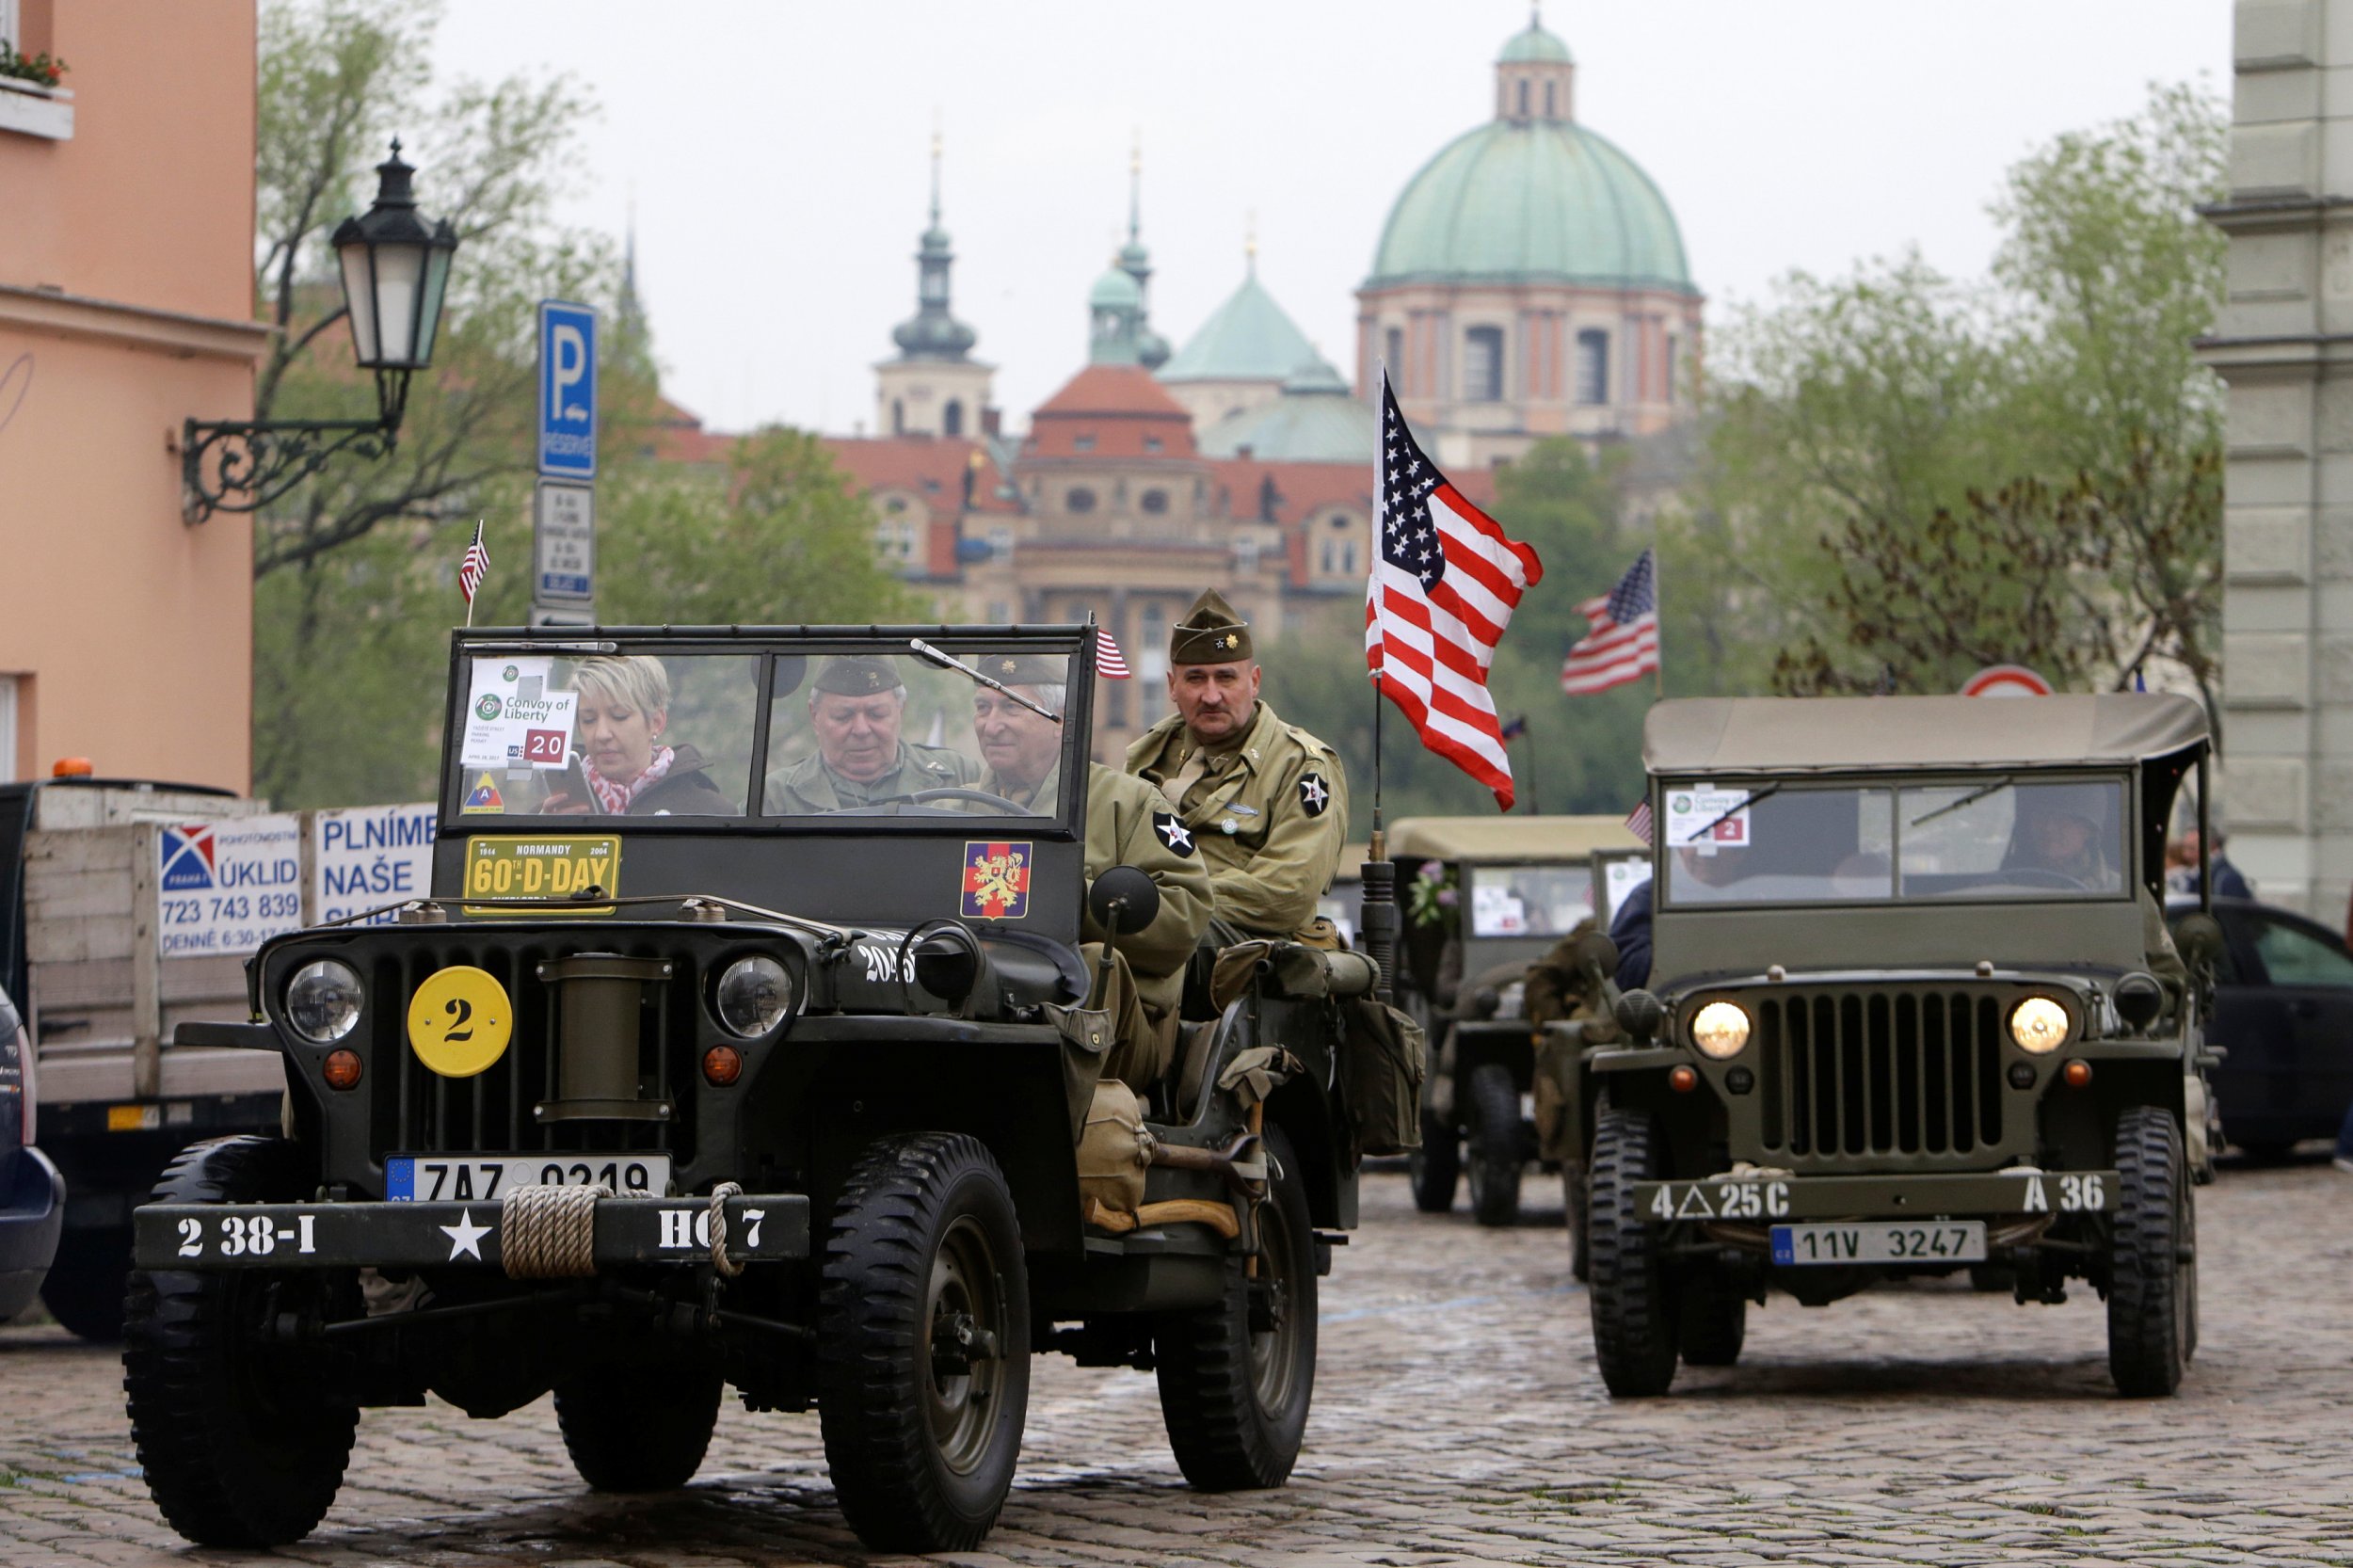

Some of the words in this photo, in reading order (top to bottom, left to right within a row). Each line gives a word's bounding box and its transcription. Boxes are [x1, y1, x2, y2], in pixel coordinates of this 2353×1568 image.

[552, 324, 586, 421] P
[504, 708, 549, 724] Liberty
[506, 696, 553, 712] Convoy
[555, 699, 570, 711] of
[531, 735, 561, 755] 20
[480, 789, 489, 799] A
[516, 845, 571, 856] NORMANDY
[220, 856, 297, 888] ÚKLID
[324, 854, 413, 896] NAŠE
[162, 899, 200, 923] 723
[211, 896, 249, 920] 743
[259, 893, 298, 918] 839
[444, 999, 473, 1042] 2
[425, 1163, 504, 1201] 7A7
[2023, 1176, 2048, 1212] A
[2059, 1174, 2105, 1211] 36
[1651, 1183, 1674, 1220] 4
[178, 1218, 203, 1256] 2
[742, 1208, 765, 1247] 7
[1802, 1230, 1859, 1259] 11V
[1888, 1228, 1968, 1257] 3247
